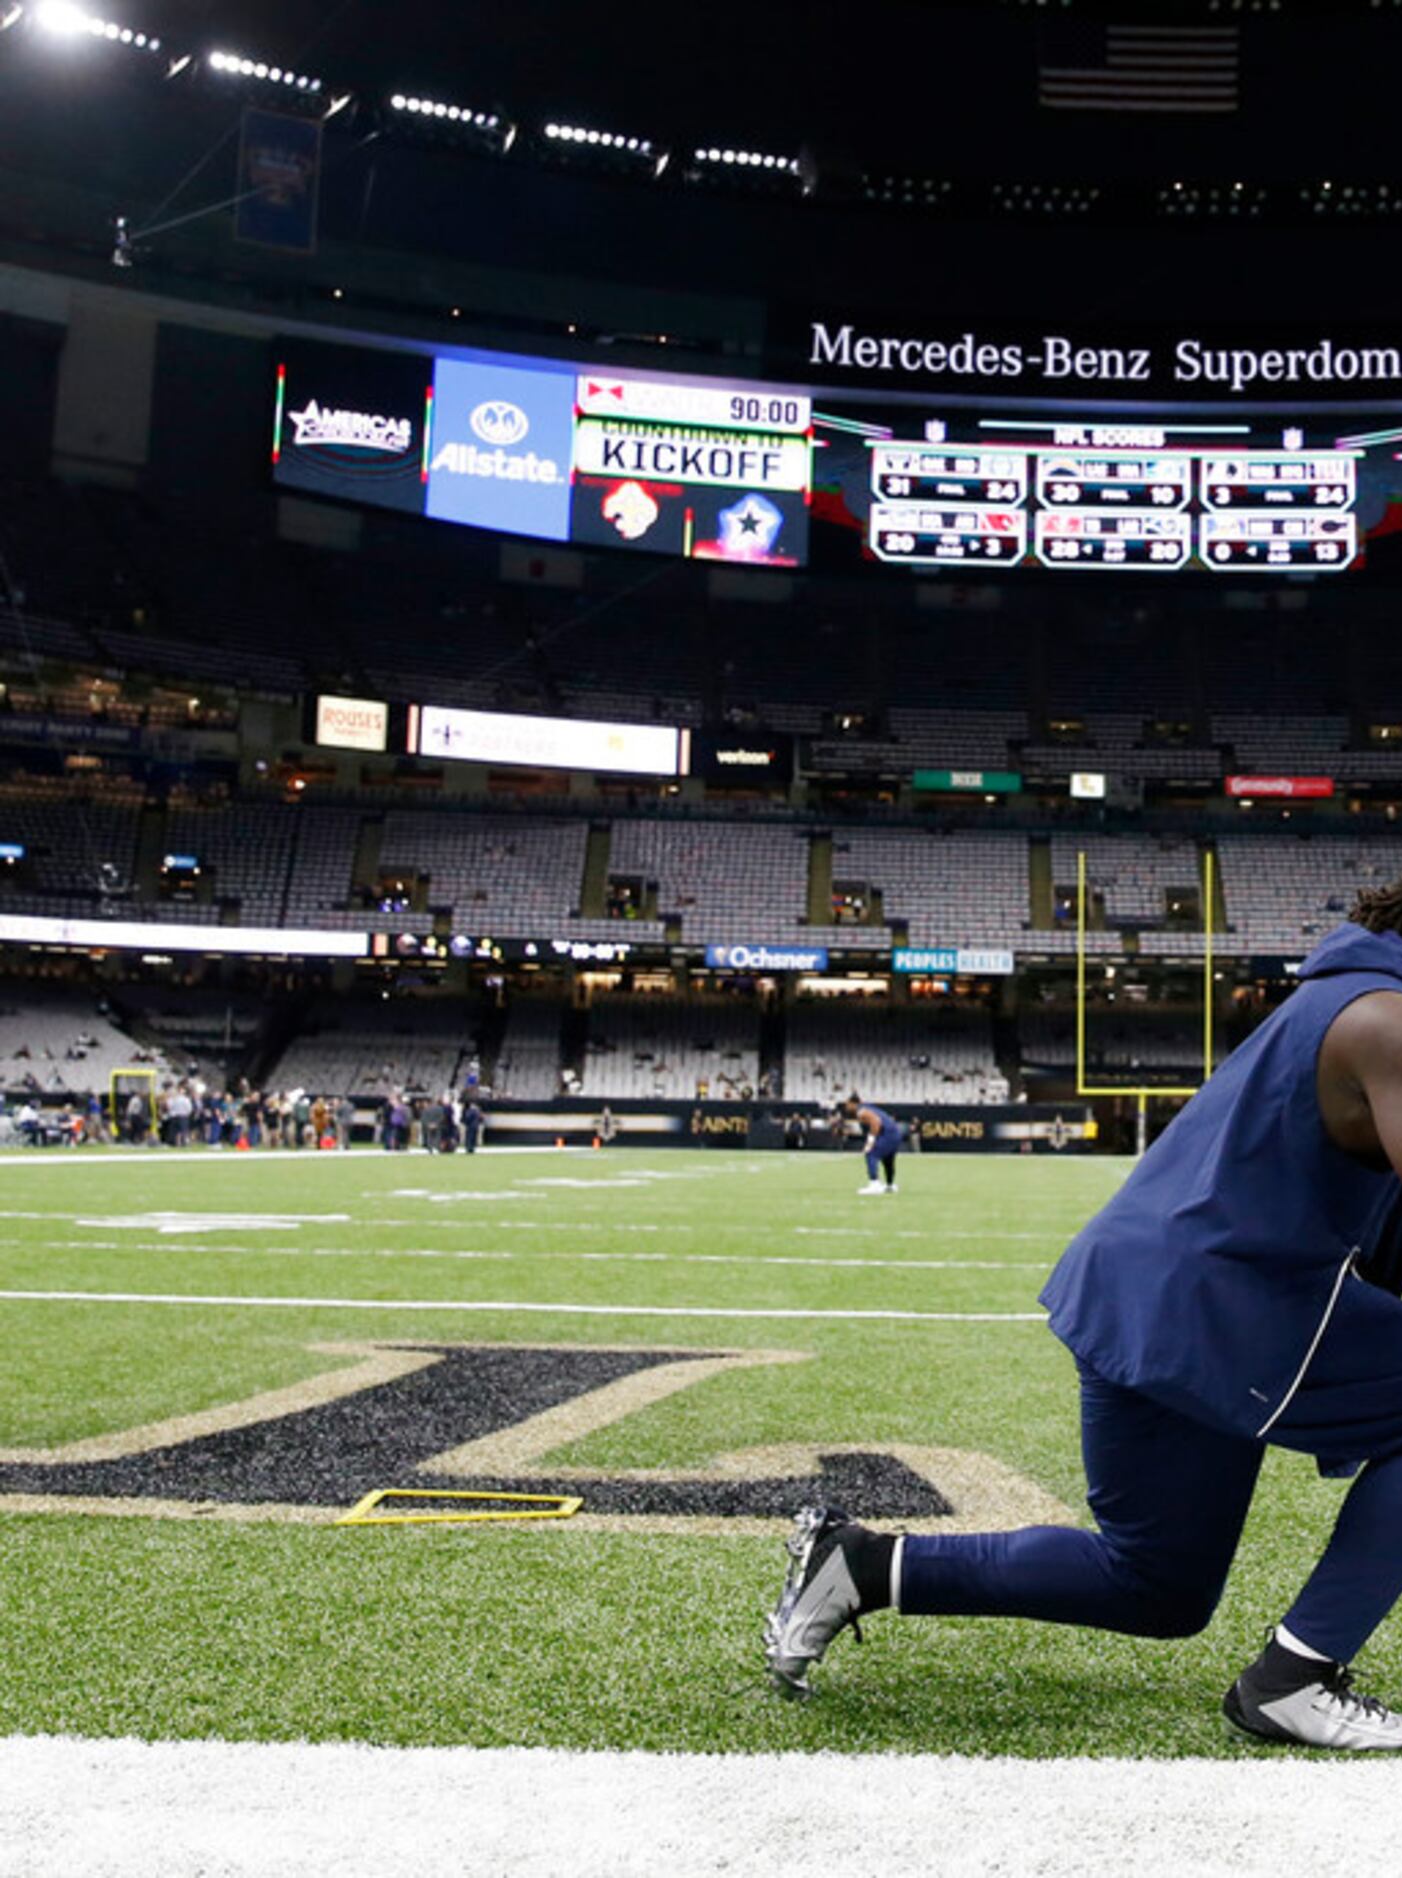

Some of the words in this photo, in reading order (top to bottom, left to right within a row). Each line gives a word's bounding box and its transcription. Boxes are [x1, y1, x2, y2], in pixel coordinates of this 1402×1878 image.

[809, 322, 1150, 380] Mercedes-Benz
[730, 396, 799, 425] 90:00
[602, 437, 783, 481] KICKOFF
[728, 946, 819, 970] Ochsner
[921, 1121, 984, 1138] SAINTS
